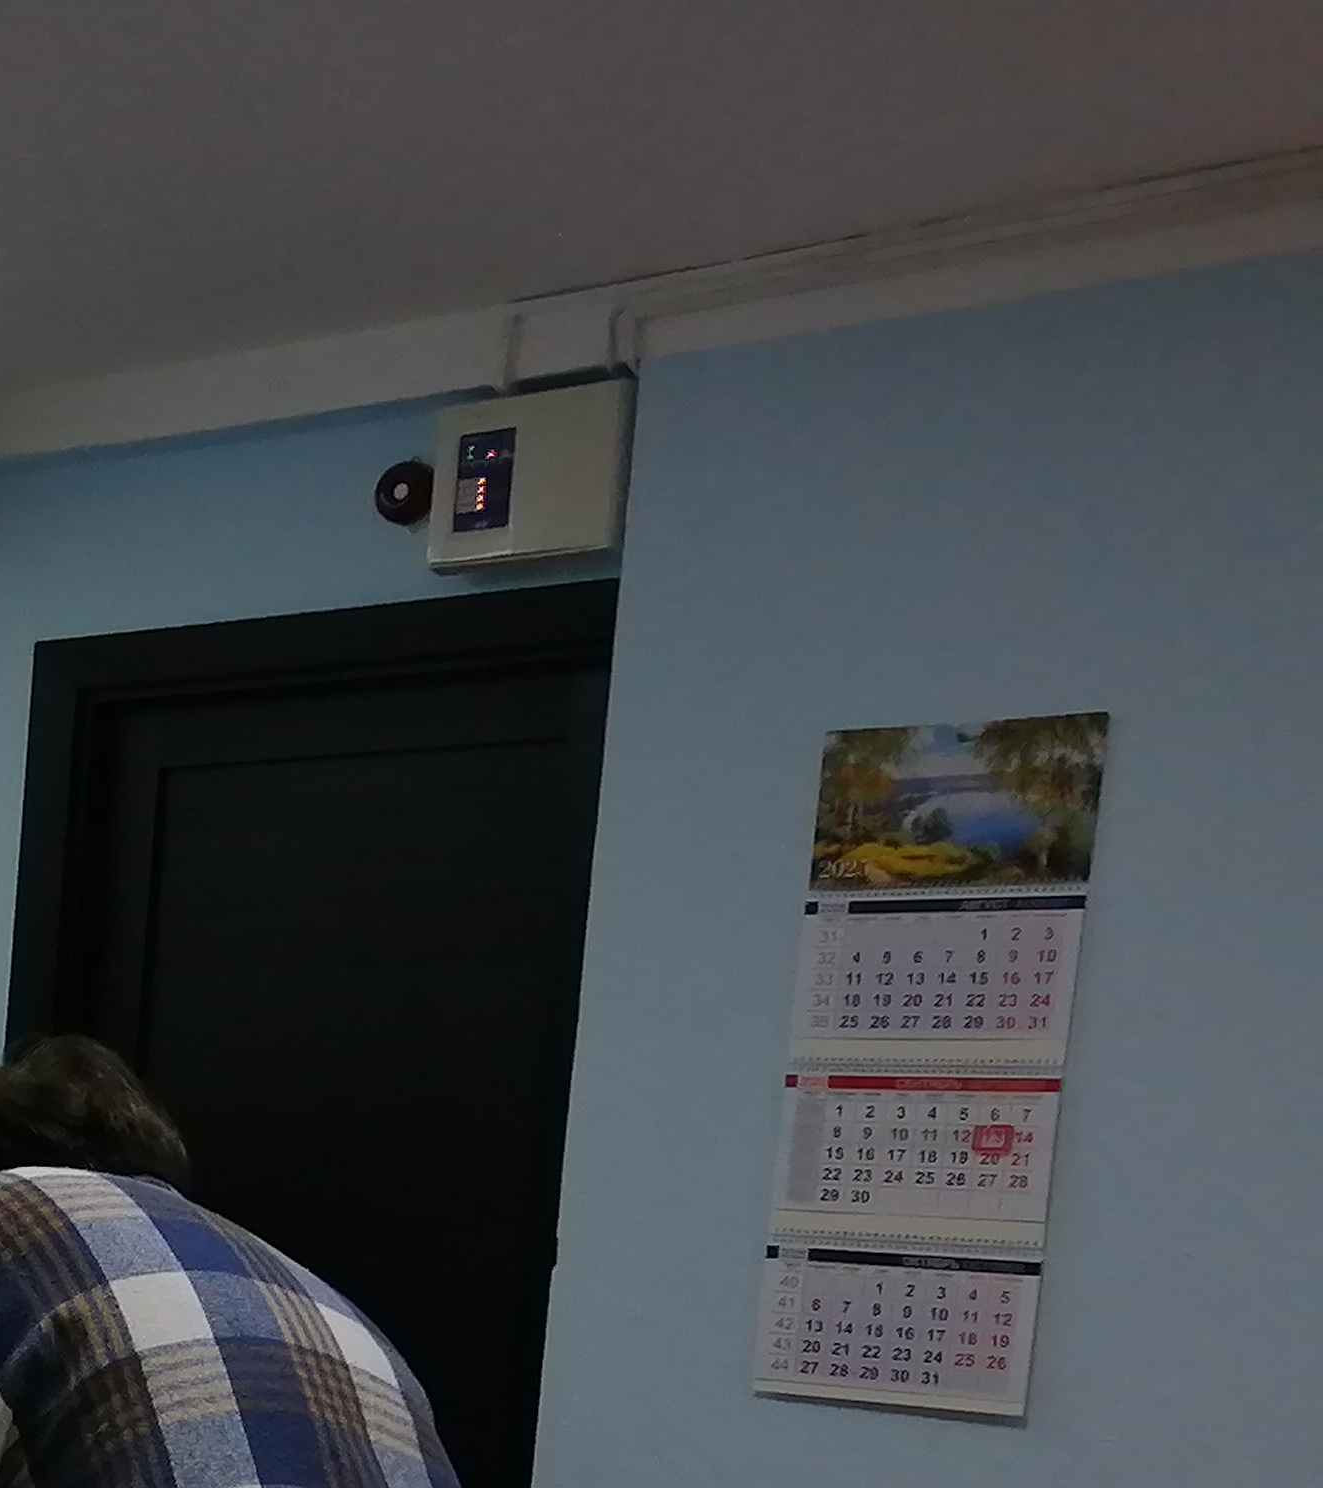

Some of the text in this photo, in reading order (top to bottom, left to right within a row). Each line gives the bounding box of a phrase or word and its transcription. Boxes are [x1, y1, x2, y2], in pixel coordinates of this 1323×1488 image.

[1037, 949, 1057, 963] 10
[846, 971, 862, 986] 11
[875, 972, 894, 986] 12
[907, 972, 925, 986] 13
[938, 971, 956, 984] 14
[969, 971, 989, 985] 15
[1002, 971, 1021, 985] 16
[1034, 971, 1054, 985] 17
[873, 993, 892, 1007] 19
[902, 993, 923, 1007] 20
[934, 993, 953, 1007] 21
[965, 993, 986, 1007] 22
[997, 993, 1018, 1007] 23
[1030, 993, 1050, 1007] 24
[838, 1015, 859, 1028] 25
[869, 1015, 890, 1029] 26
[900, 1015, 921, 1029] 27
[931, 1015, 952, 1029] 28
[962, 1015, 984, 1029] 29
[996, 1015, 1016, 1029] 30
[1028, 1016, 1047, 1029] 31
[891, 1128, 909, 1141] 10
[921, 1128, 937, 1141] 11
[953, 1129, 971, 1143] 12
[1015, 1130, 1034, 1143] 14
[826, 1147, 844, 1160] 15
[857, 1147, 875, 1161] 16
[888, 1149, 907, 1161] 17
[918, 1149, 937, 1163] 18
[979, 1152, 1000, 1165] 20
[1011, 1152, 1030, 1166] 21
[822, 1167, 842, 1181] 22
[852, 1169, 872, 1182] 23
[883, 1170, 903, 1183] 24
[915, 1171, 935, 1184] 25
[977, 1173, 998, 1187] 27
[1008, 1174, 1028, 1188] 28
[820, 1188, 871, 1203] 29 30
[930, 1307, 949, 1320] 10
[962, 1310, 978, 1322] 11
[993, 1313, 1013, 1326] 12
[806, 1319, 823, 1333] 13
[836, 1321, 853, 1334] 14
[896, 1327, 915, 1340] 16
[927, 1329, 946, 1341] 17
[958, 1331, 978, 1345] 18
[992, 1334, 1010, 1348] 19
[802, 1340, 821, 1353] 20
[831, 1342, 849, 1356] 21
[862, 1345, 882, 1359] 22
[892, 1347, 912, 1361] 23
[923, 1350, 943, 1363] 24
[954, 1353, 975, 1367] 25
[985, 1355, 1007, 1370] 26
[799, 1360, 819, 1374] 27
[829, 1363, 850, 1377] 28
[859, 1366, 879, 1380] 29
[890, 1369, 910, 1383] 30
[921, 1372, 939, 1385] 31
